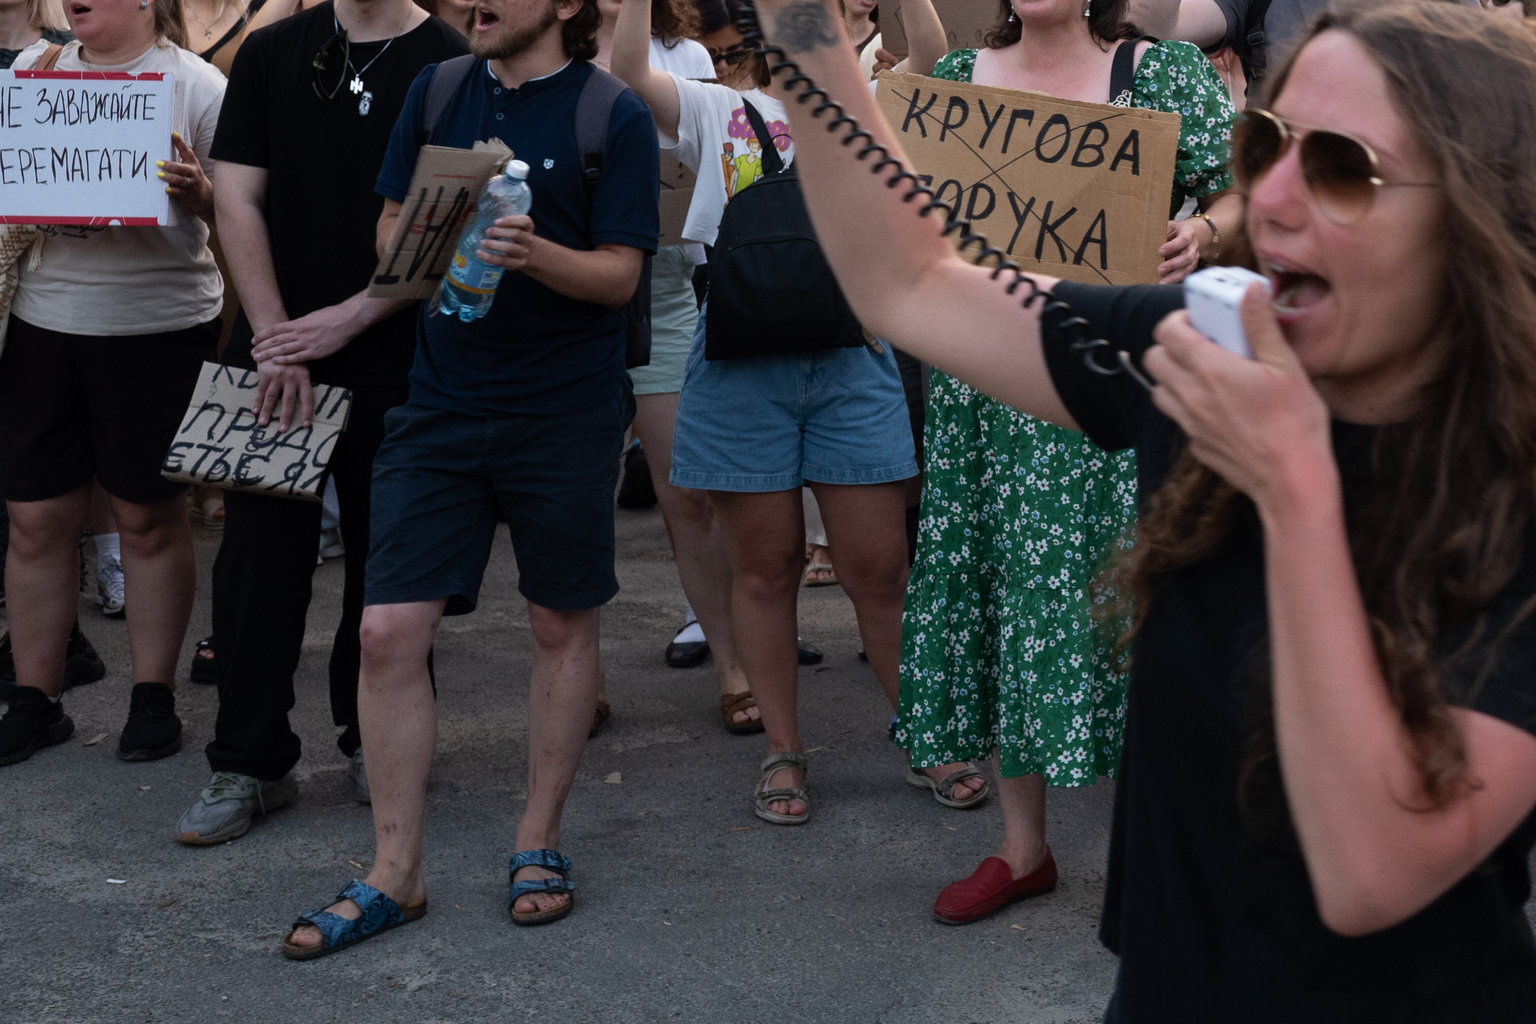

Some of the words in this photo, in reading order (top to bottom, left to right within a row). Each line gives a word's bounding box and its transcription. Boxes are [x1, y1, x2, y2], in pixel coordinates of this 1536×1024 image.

[34, 83, 156, 126] ЗАВАЖАЙТЕ
[901, 88, 1141, 176] КРУГОВА
[0, 147, 149, 185] ЕРЕМАГАТИ
